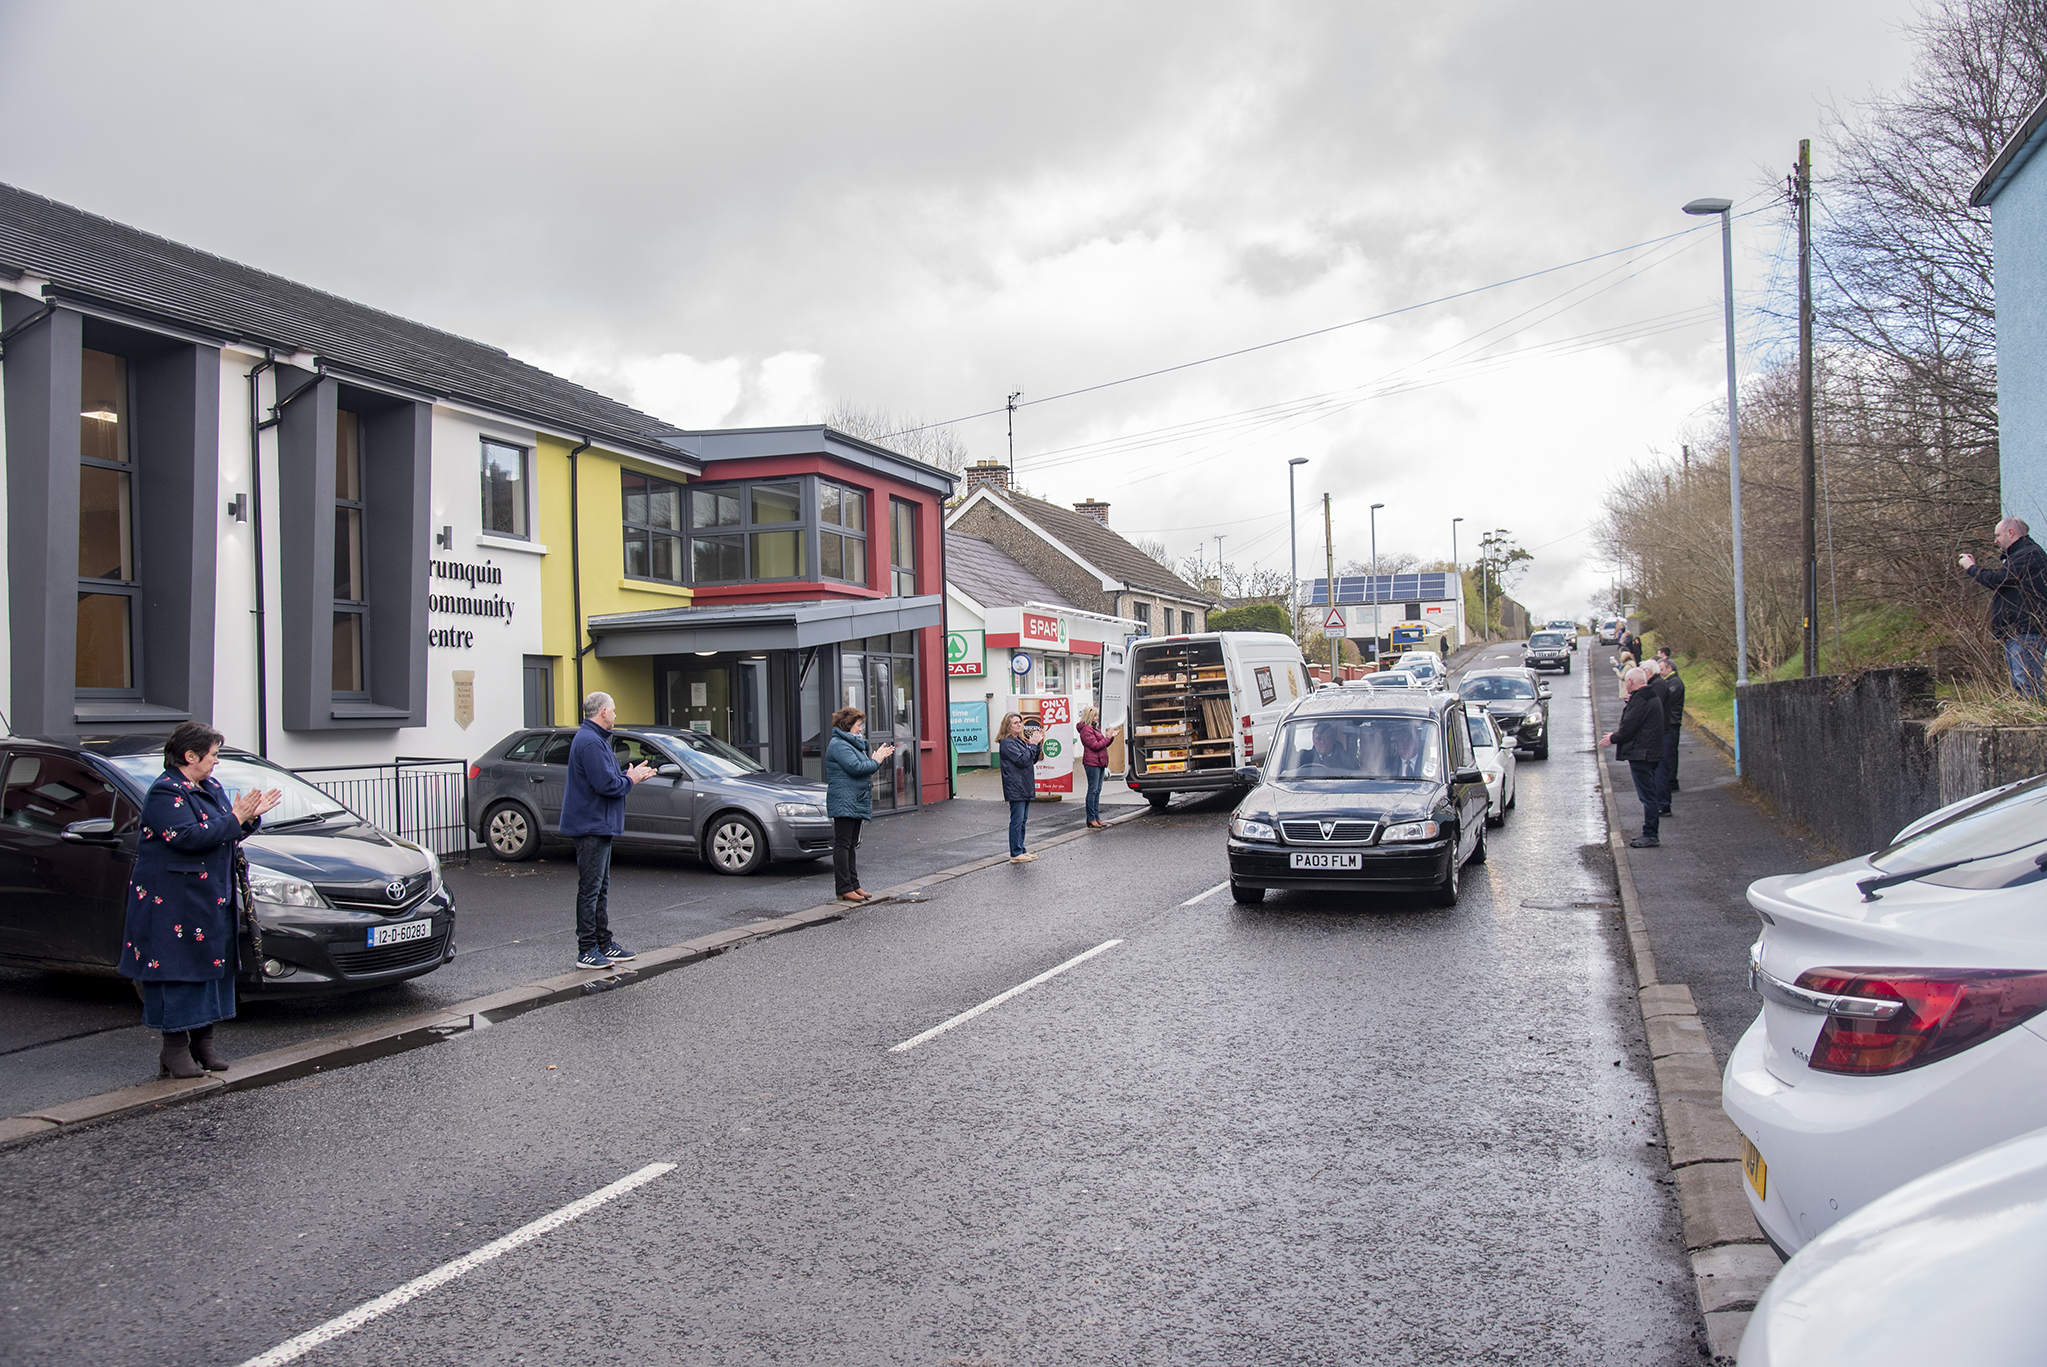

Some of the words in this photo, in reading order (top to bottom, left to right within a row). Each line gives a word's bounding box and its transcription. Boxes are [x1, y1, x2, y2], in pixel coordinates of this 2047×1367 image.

[429, 559, 502, 589] rumquin
[429, 593, 515, 625] ommunity
[429, 625, 474, 648] entre
[1030, 618, 1058, 637] SPAR
[948, 664, 977, 673] PAR
[1042, 699, 1067, 709] ONLY
[1043, 707, 1068, 724] £4
[1296, 855, 1328, 866] PA03
[1332, 856, 1356, 866] FLM
[379, 924, 426, 944] 12-D-60283
